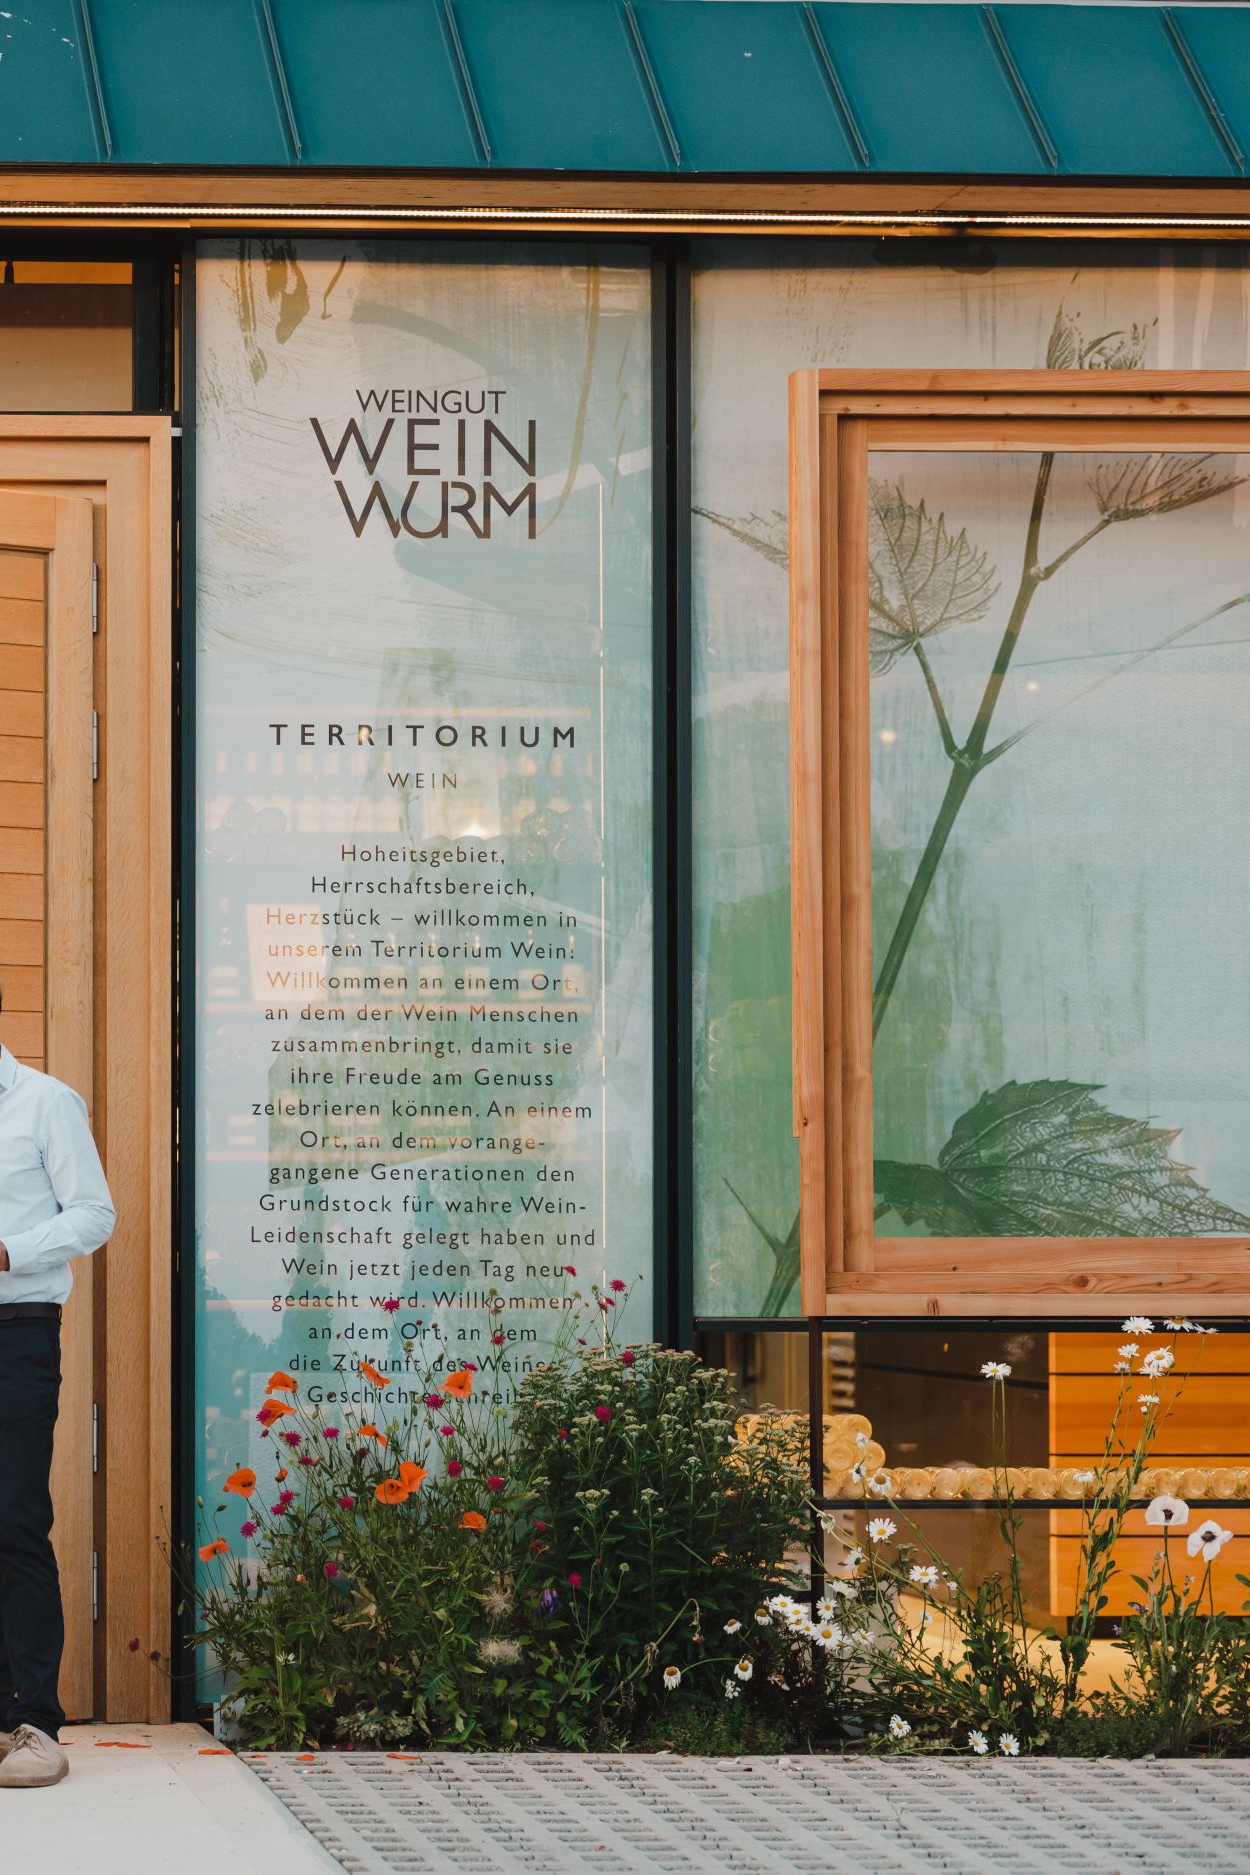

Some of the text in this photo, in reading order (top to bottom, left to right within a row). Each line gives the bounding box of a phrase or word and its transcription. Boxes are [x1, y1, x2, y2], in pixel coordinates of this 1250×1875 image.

[356, 389, 506, 414] WEINGUT
[309, 417, 537, 477] WEIN
[334, 480, 537, 540] WURM
[268, 723, 577, 749] TERRITORIUM
[387, 772, 459, 790] WEIN
[341, 844, 505, 867] Hoheitsgebiet,
[311, 876, 535, 897] Herrschaftsbereich,
[266, 907, 381, 926] Herzstück
[413, 909, 548, 928] willkommen
[558, 911, 578, 928] in
[268, 943, 363, 958] unserem
[370, 940, 502, 959] Territorium
[266, 971, 579, 993] Willkommen an einem Ort,
[264, 1003, 579, 1023] an dem der Wein Menschen
[271, 1035, 573, 1059] zusammenbringt, damit sie
[290, 1066, 554, 1087] ihre Freude am Genuss
[251, 1099, 592, 1119] zelebrieren können. An einem
[300, 1130, 545, 1155] Ort, an dem vorange-
[269, 1163, 575, 1185] gangene Generationen den
[259, 1194, 587, 1214] Grundstock für wahre Wein-
[250, 1226, 596, 1250] Leidenschaft gelegt haben und
[282, 1258, 565, 1282] Wein jetzt jeden Tag neu
[272, 1290, 359, 1312] gedacht
[432, 1291, 573, 1310] Willkommen
[308, 1326, 333, 1340] an
[344, 1322, 389, 1340] dem
[400, 1322, 449, 1343] Ort,
[457, 1328, 481, 1341] an
[289, 1354, 322, 1372] die
[476, 1355, 558, 1373] Wein
